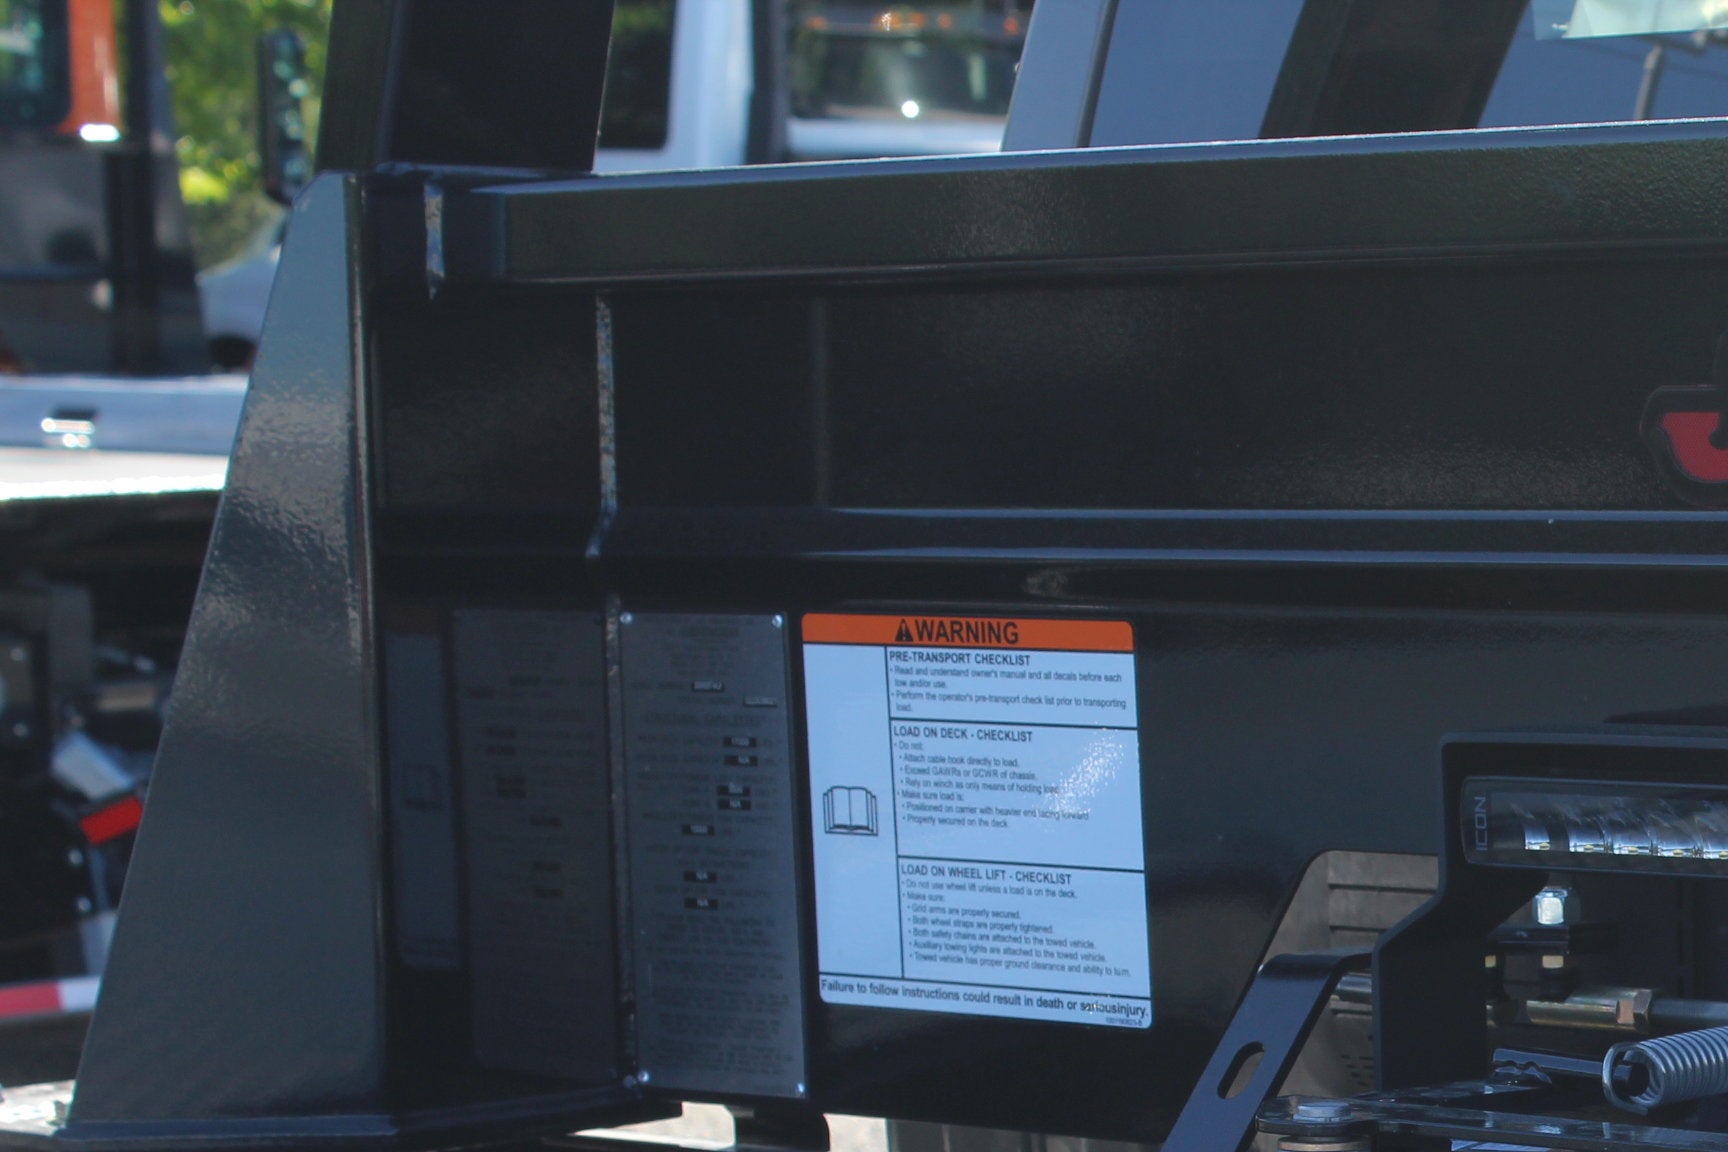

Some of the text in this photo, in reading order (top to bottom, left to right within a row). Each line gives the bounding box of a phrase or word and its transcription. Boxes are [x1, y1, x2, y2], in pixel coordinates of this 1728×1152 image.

[915, 618, 1018, 644] WARNING
[889, 651, 1030, 666] PRE-TRANSPORT CHECKLIST
[915, 667, 928, 675] and
[930, 668, 969, 677] understand
[1000, 671, 1026, 679] manual
[1028, 672, 1042, 680] and
[1053, 671, 1077, 681] decals
[1078, 672, 1102, 681] before
[1103, 673, 1122, 682] each
[896, 690, 924, 700] Perform
[925, 692, 936, 700] the
[974, 694, 1019, 705] pre-transport
[1021, 696, 1042, 705] check
[1055, 697, 1073, 706] prior
[1075, 697, 1082, 705] to
[1083, 698, 1126, 710] transporting
[893, 726, 920, 737] LOAD
[922, 727, 938, 738] ON
[940, 728, 968, 739] DECK
[976, 729, 1032, 742] CHECKLIST
[898, 741, 909, 750] Do
[966, 756, 991, 766] directly
[992, 758, 1000, 766] to
[972, 768, 999, 778] GCWR
[965, 781, 980, 791] only
[1007, 783, 1015, 791] of
[1016, 783, 1042, 795] holding
[922, 792, 938, 800] sure
[939, 791, 955, 801] load
[967, 818, 976, 826] on
[977, 818, 989, 827] the
[1474, 796, 1488, 851] ICON
[901, 864, 928, 876] LOAD
[930, 865, 945, 877] ON
[948, 866, 982, 880] WHEEL
[985, 869, 1006, 881] LIFT
[1015, 871, 1072, 885] CHECKLIST
[906, 878, 917, 888] Do
[945, 881, 967, 891] wheel
[1009, 885, 1025, 895] load
[1034, 889, 1044, 897] on
[1045, 888, 1056, 897] the
[961, 908, 990, 919] properly
[989, 921, 1018, 933] properly
[1023, 935, 1031, 944] to
[1033, 936, 1044, 945] the
[1034, 949, 1042, 958] to
[1043, 949, 1055, 958] the
[979, 957, 1003, 967] proper
[1004, 959, 1029, 970] ground
[1067, 963, 1081, 972] and
[1104, 966, 1112, 976] to
[821, 979, 854, 993] Failure
[857, 983, 867, 993] to
[869, 983, 899, 996] follow
[901, 985, 960, 1000] instructions
[962, 990, 990, 1003] could
[993, 993, 1021, 1006] result
[1023, 994, 1034, 1007] in
[1036, 997, 1064, 1010] death
[1066, 1000, 1078, 1010] or
